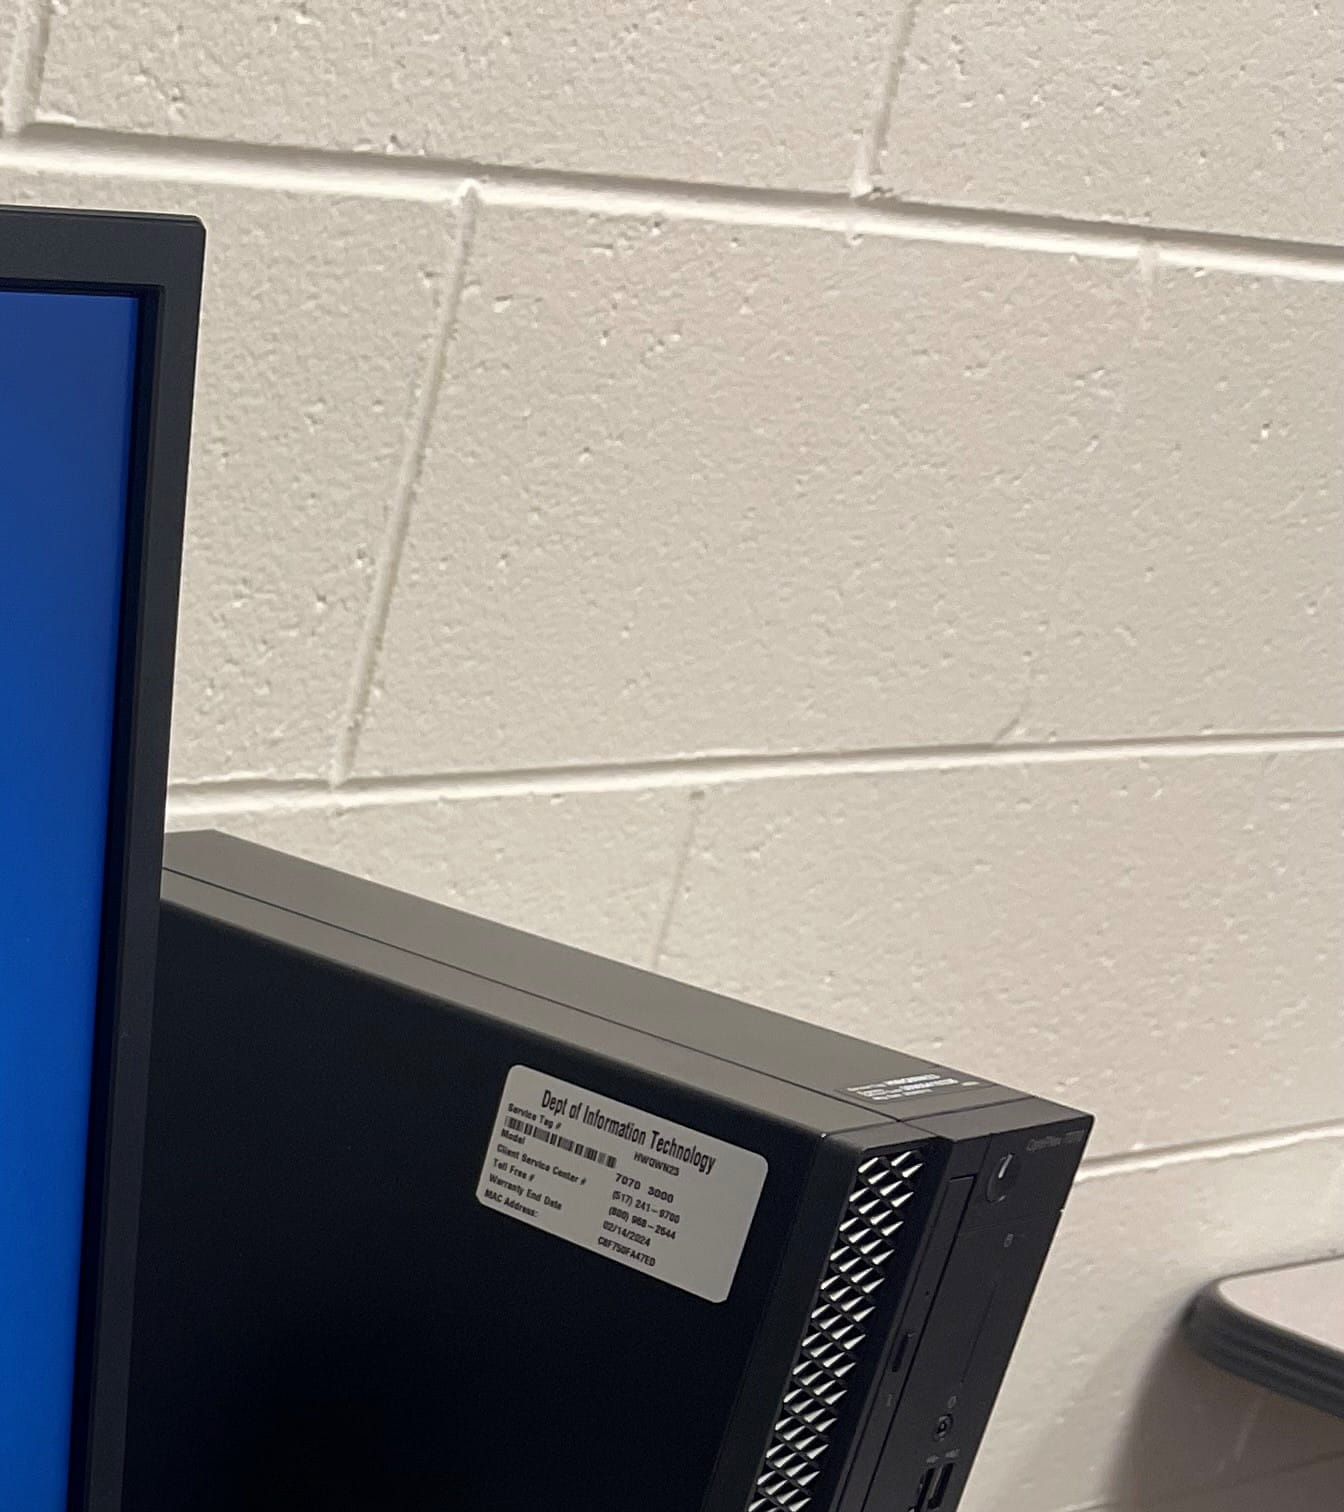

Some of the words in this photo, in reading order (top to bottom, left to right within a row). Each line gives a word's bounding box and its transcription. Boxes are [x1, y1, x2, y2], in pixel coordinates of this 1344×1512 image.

[509, 1104, 536, 1120] Service
[541, 1089, 567, 1115] Dept
[568, 1101, 583, 1120] of
[582, 1105, 647, 1145] Information
[651, 1130, 717, 1175] Technology
[501, 1129, 525, 1144] Model
[616, 1173, 640, 1189] 7070
[648, 1187, 673, 1203] 3000
[522, 1154, 550, 1171] Service
[485, 1190, 502, 1202] MAC
[527, 1189, 541, 1201] End
